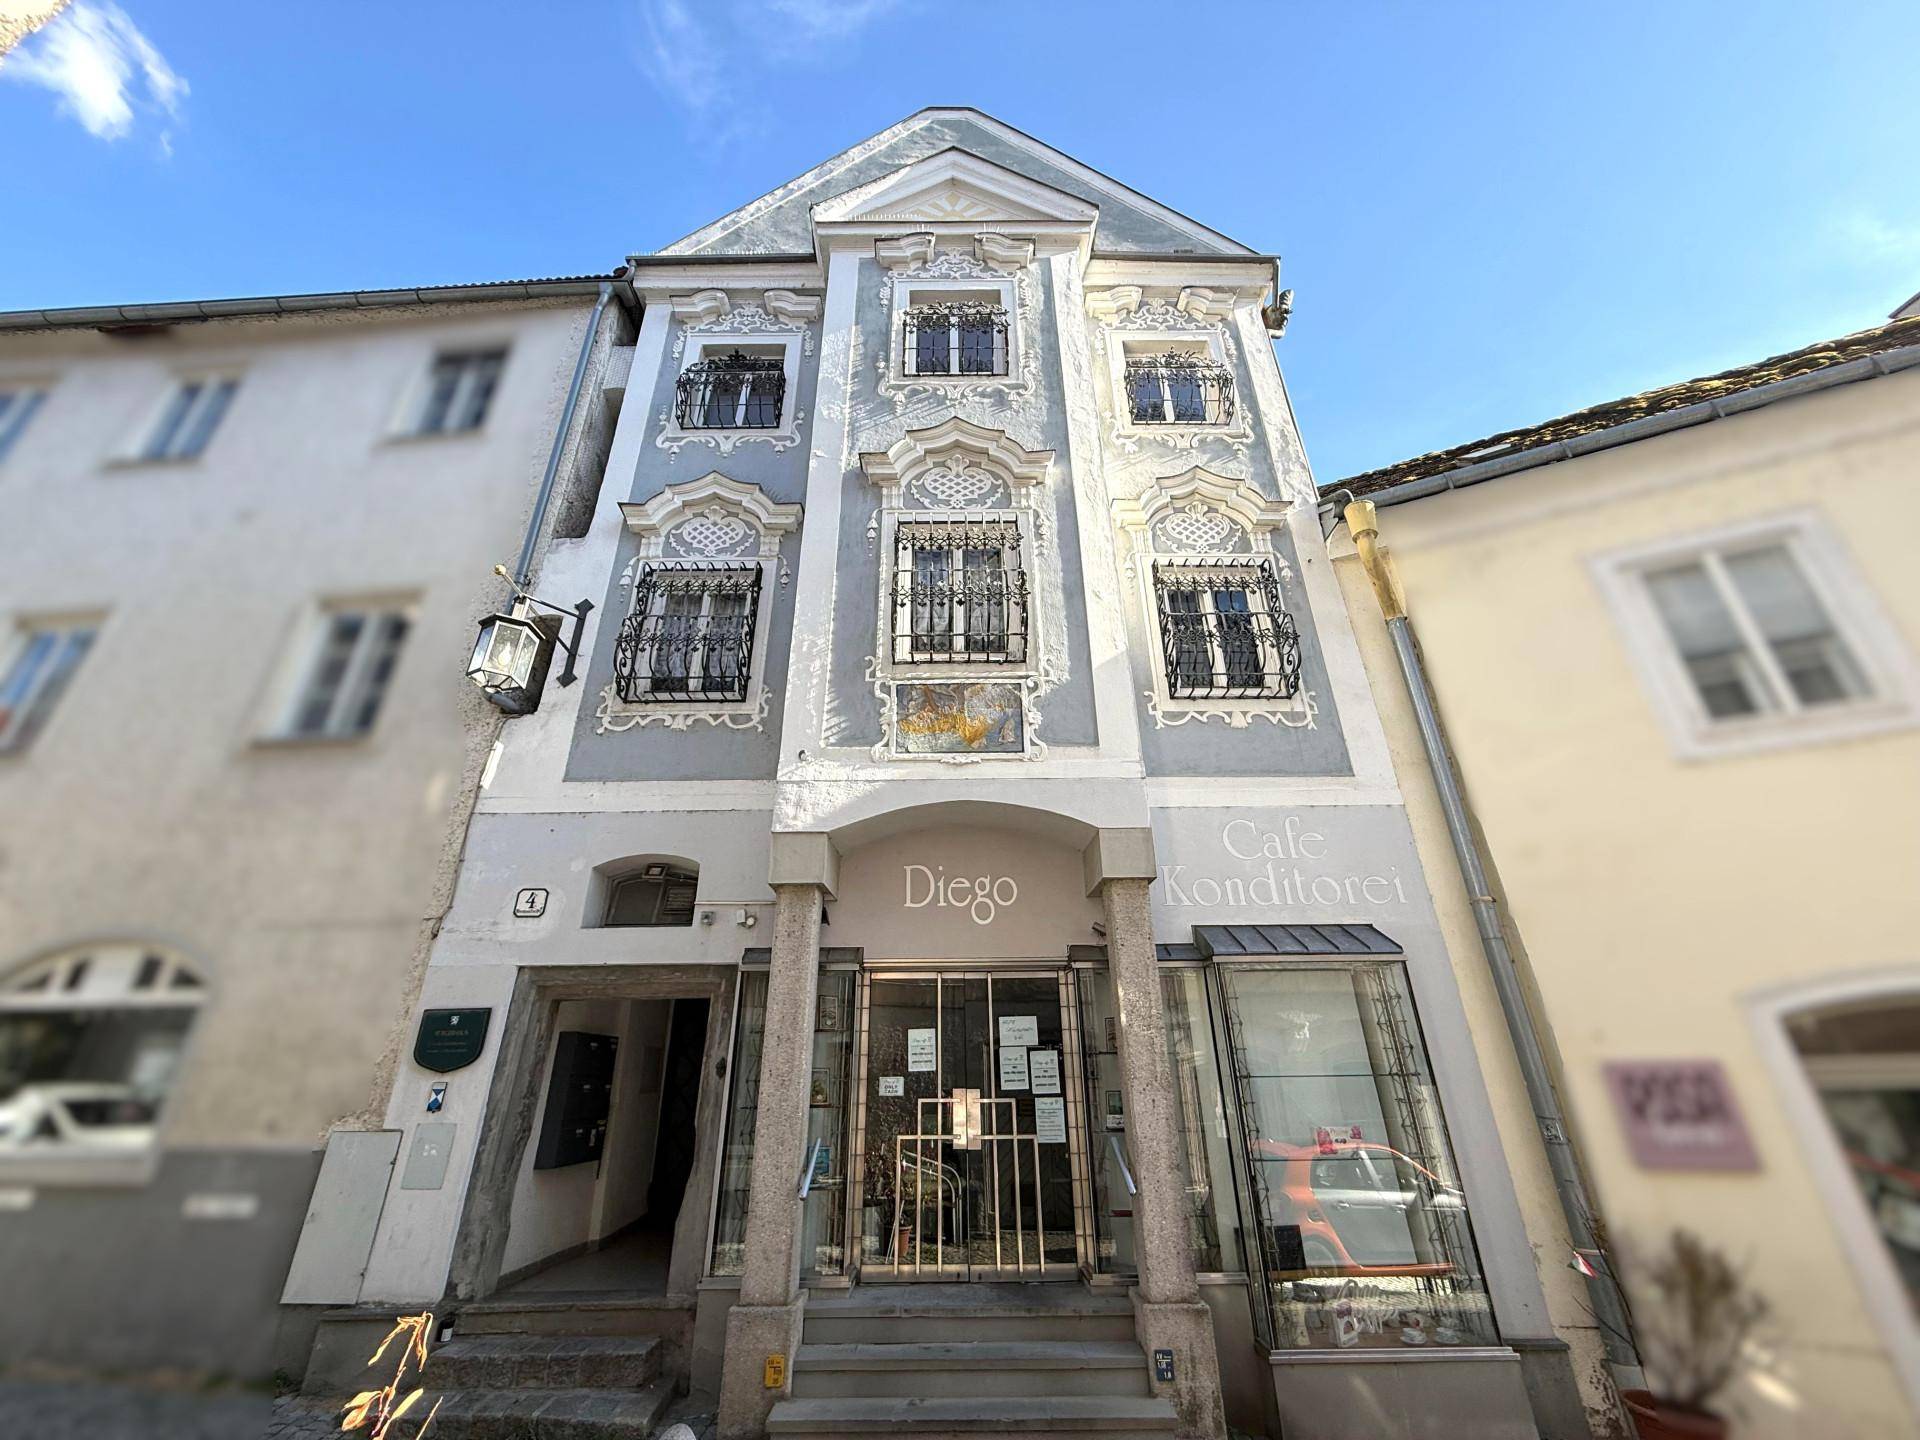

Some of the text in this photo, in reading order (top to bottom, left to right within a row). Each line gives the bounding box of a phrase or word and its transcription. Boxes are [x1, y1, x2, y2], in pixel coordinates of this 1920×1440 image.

[1222, 816, 1328, 860] Cafe
[525, 891, 536, 908] 4
[903, 864, 1018, 925] Diego
[1160, 861, 1408, 906] Konditorei
